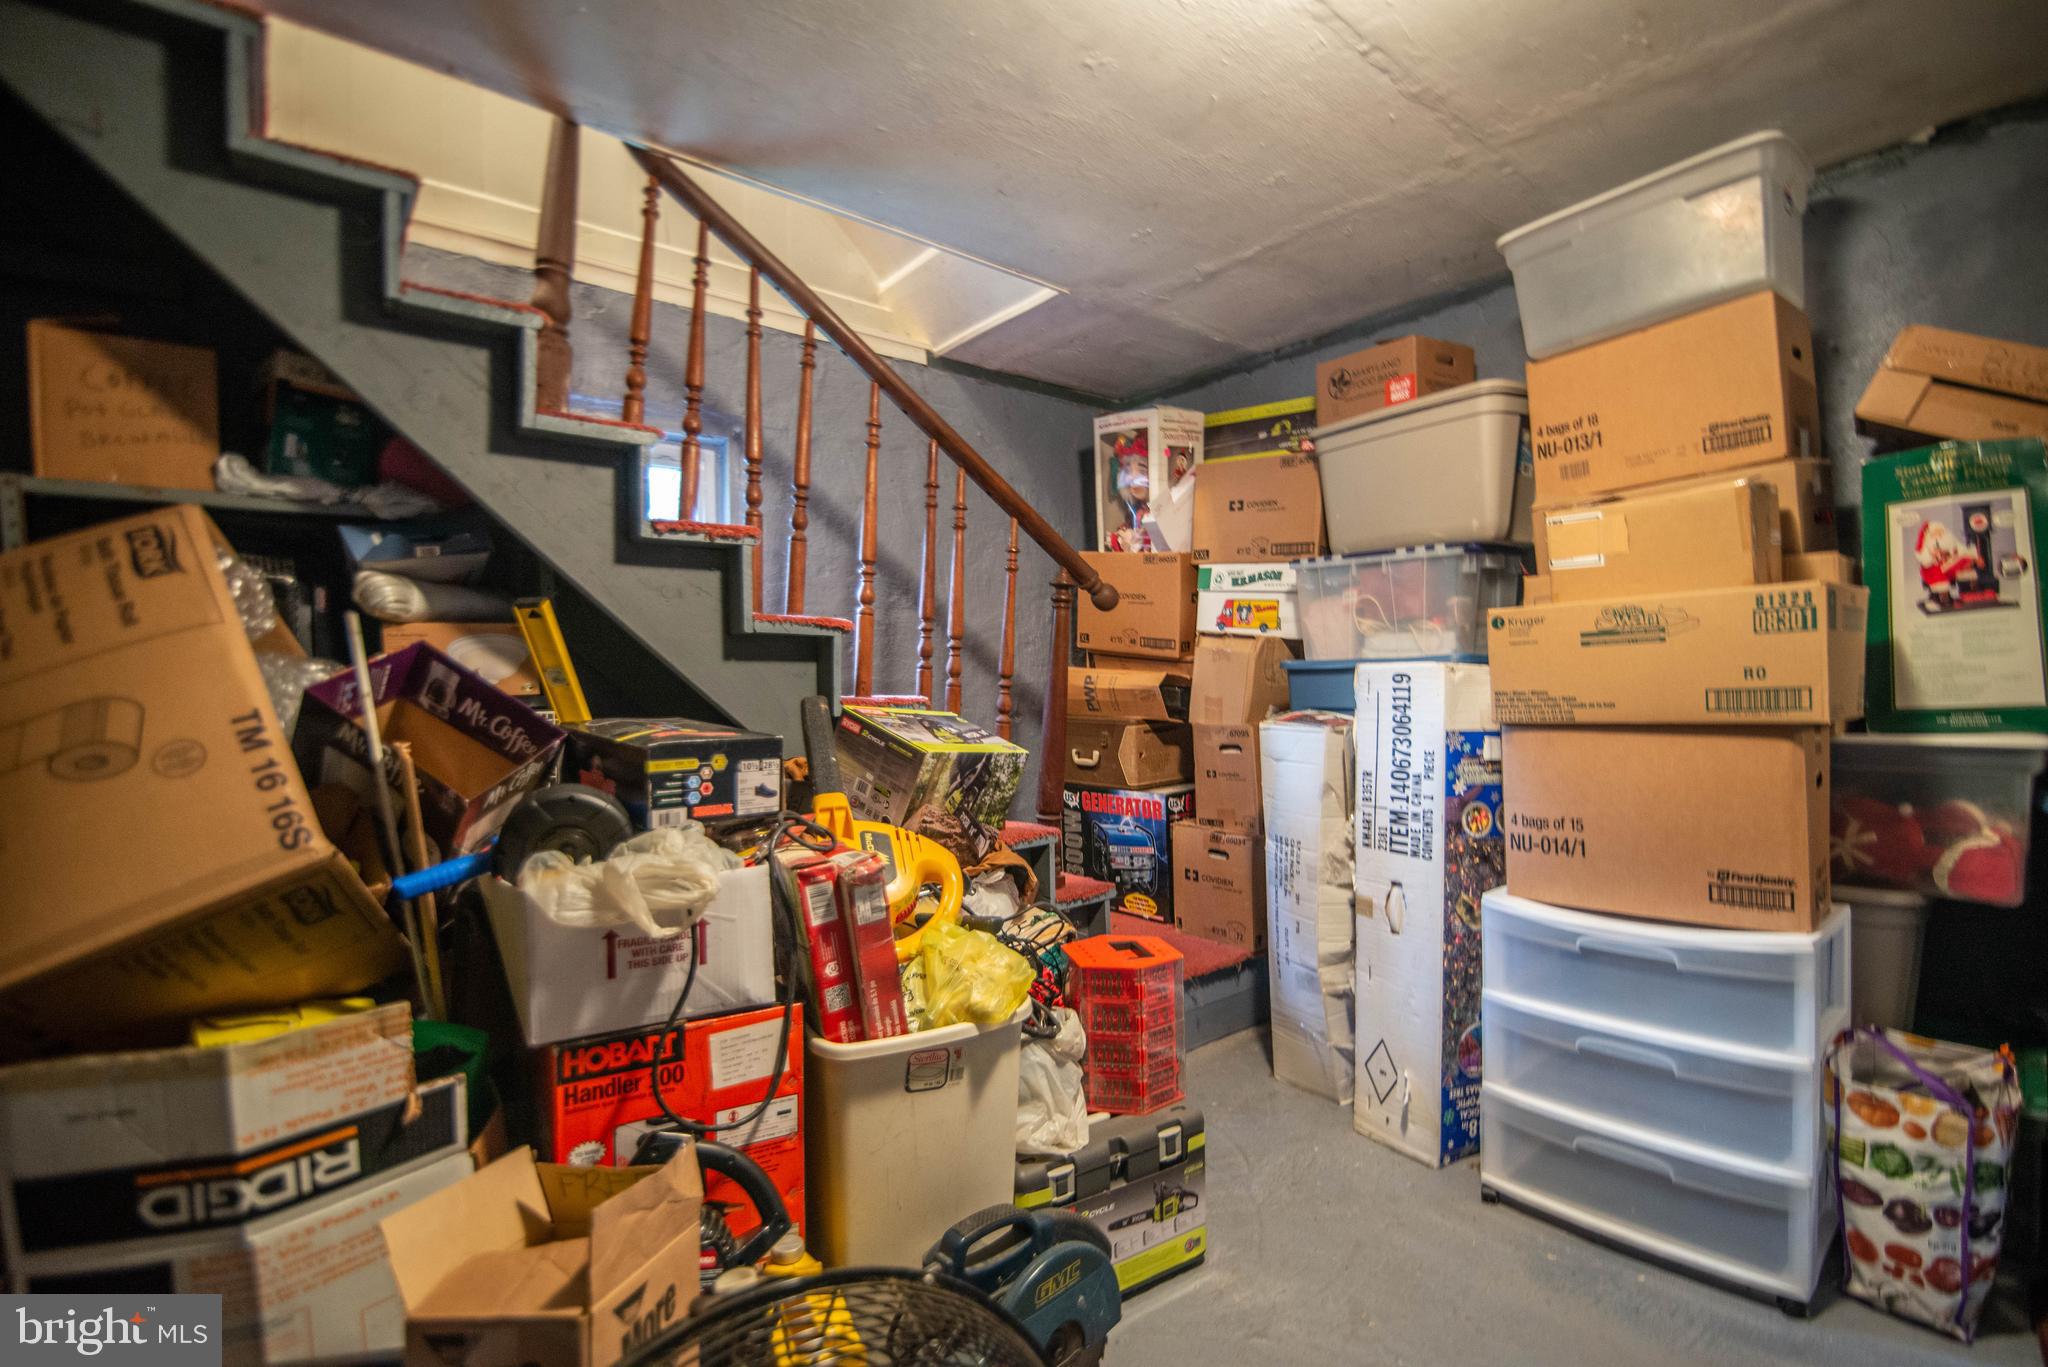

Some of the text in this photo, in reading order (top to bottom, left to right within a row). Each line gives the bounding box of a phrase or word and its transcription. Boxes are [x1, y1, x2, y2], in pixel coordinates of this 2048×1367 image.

[1537, 426, 1544, 437] 4
[1546, 422, 1570, 436] bags
[1572, 416, 1583, 430] of
[1537, 430, 1603, 461] NU-013/1
[1507, 615, 1546, 627] Kruger
[459, 696, 538, 758] Mr. Coffee
[231, 707, 312, 851] TM 16 16S
[1423, 749, 1435, 781] PIECE
[1081, 790, 1163, 822] GENERATOR
[1411, 773, 1423, 807] CHINA
[1422, 809, 1434, 862] CONTENTS
[1511, 814, 1584, 833] 4 bags of 15
[1410, 827, 1422, 859] MADE
[1510, 834, 1587, 859] NU-014/1
[627, 952, 689, 971] THIS SIDE UP
[632, 942, 685, 959] WITH CARE
[562, 1030, 679, 1079] HOBART
[563, 1077, 642, 1108] Handler
[136, 1138, 362, 1229] RIDGID
